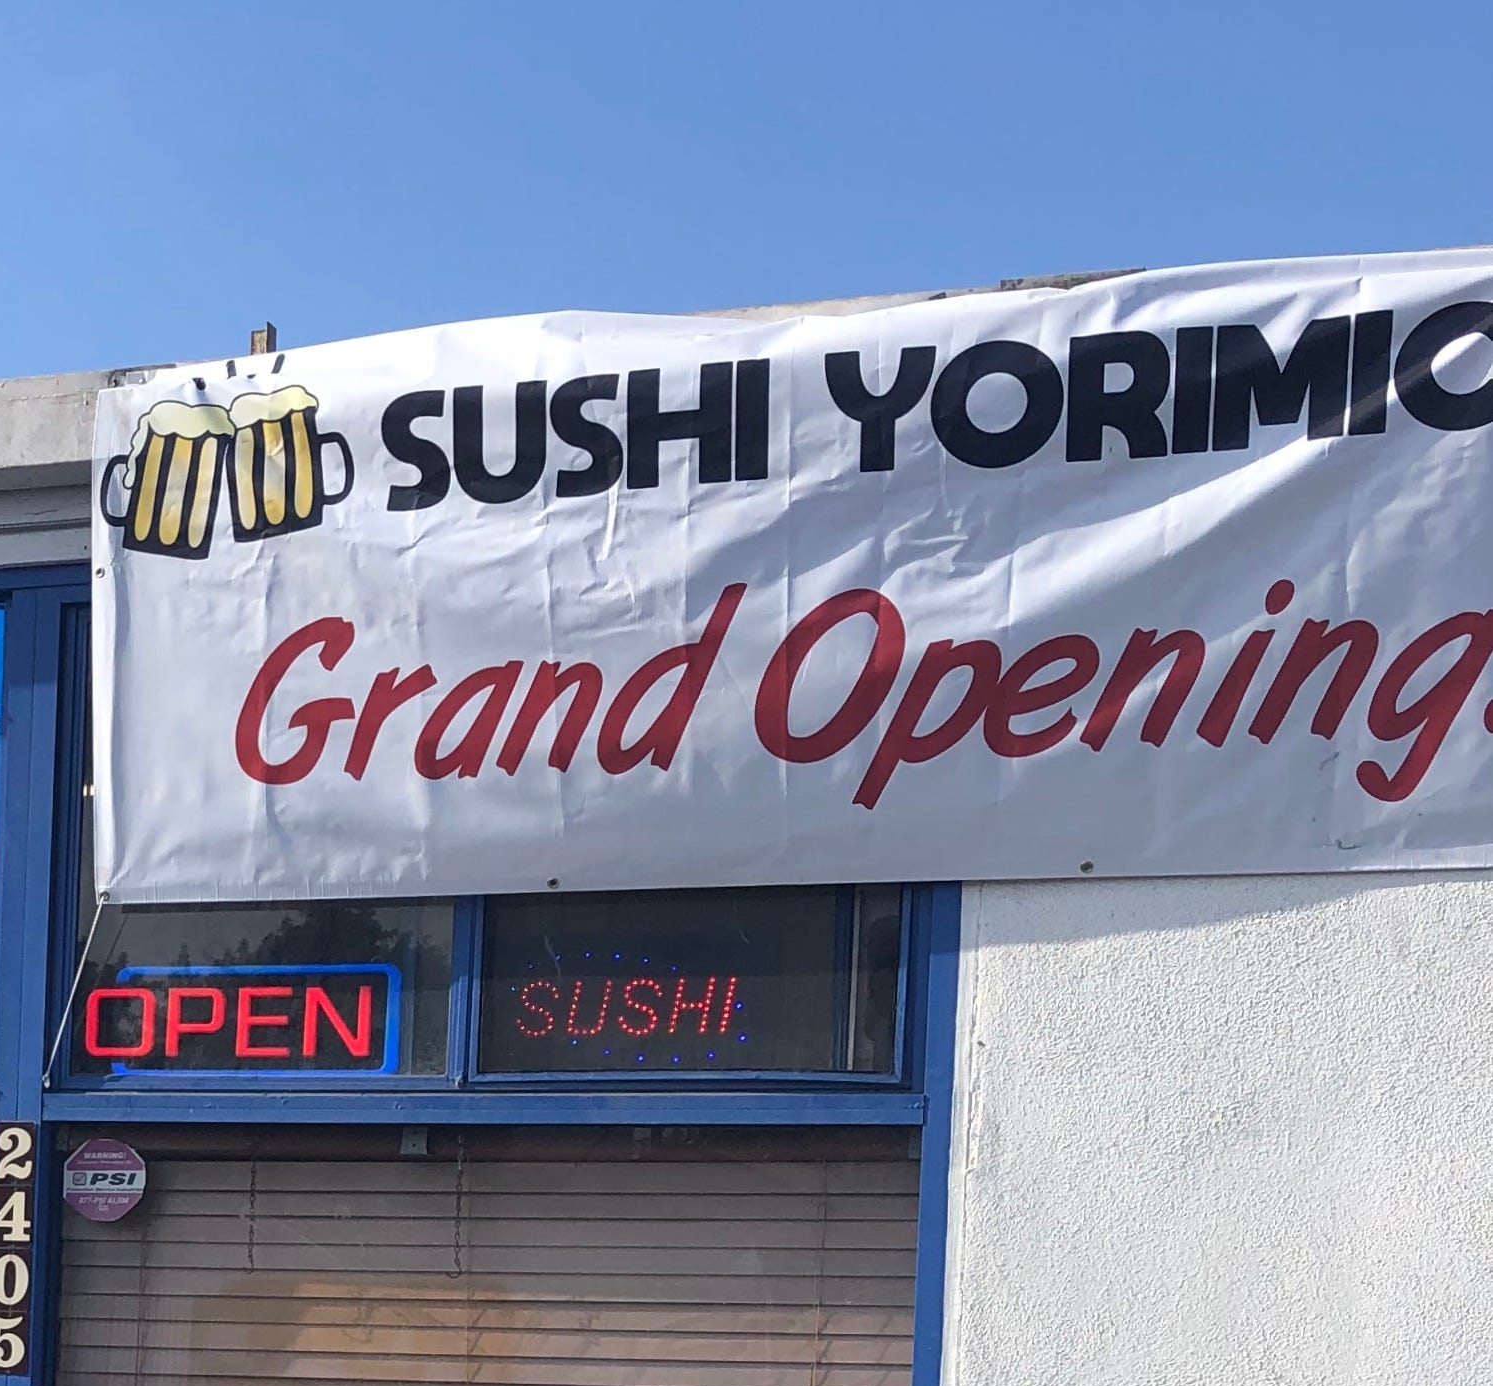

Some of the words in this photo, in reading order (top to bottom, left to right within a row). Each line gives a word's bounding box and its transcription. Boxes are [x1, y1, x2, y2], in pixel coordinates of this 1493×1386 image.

[380, 357, 771, 512] SUSHI
[234, 581, 748, 786] Grand
[84, 985, 373, 1058] OPEN
[514, 975, 739, 1038] SUSHI
[89, 1172, 137, 1186] PSI
